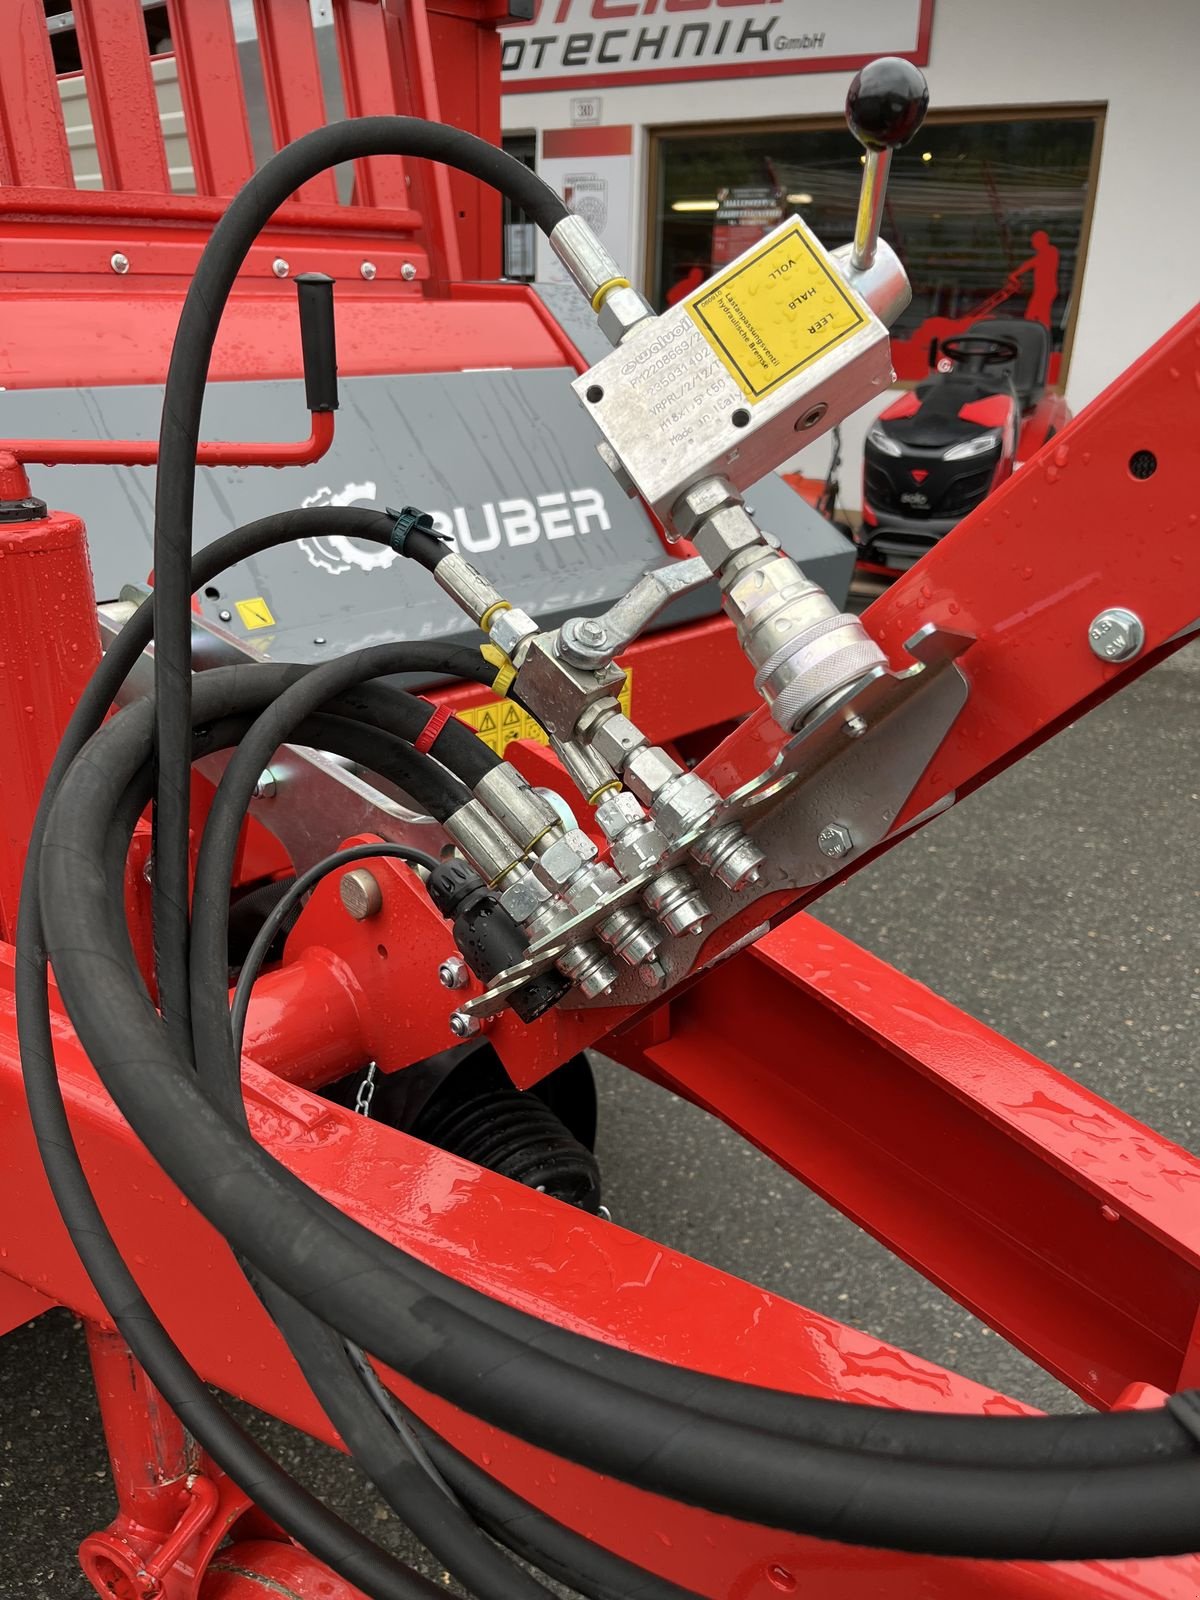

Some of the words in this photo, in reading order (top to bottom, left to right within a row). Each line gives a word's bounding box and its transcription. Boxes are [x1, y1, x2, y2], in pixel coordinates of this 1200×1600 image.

[774, 33, 825, 50] GmbH
[769, 259, 797, 280] VOLL
[788, 287, 817, 310] HALB
[635, 315, 694, 364] walvoil
[718, 298, 750, 343] hydraulische
[748, 342, 769, 369] Bremse
[725, 292, 780, 367] Lastanpassungsventil
[808, 313, 834, 335] LEER
[669, 426, 694, 446] Made
[698, 414, 711, 425] in
[713, 390, 743, 413] Italy
